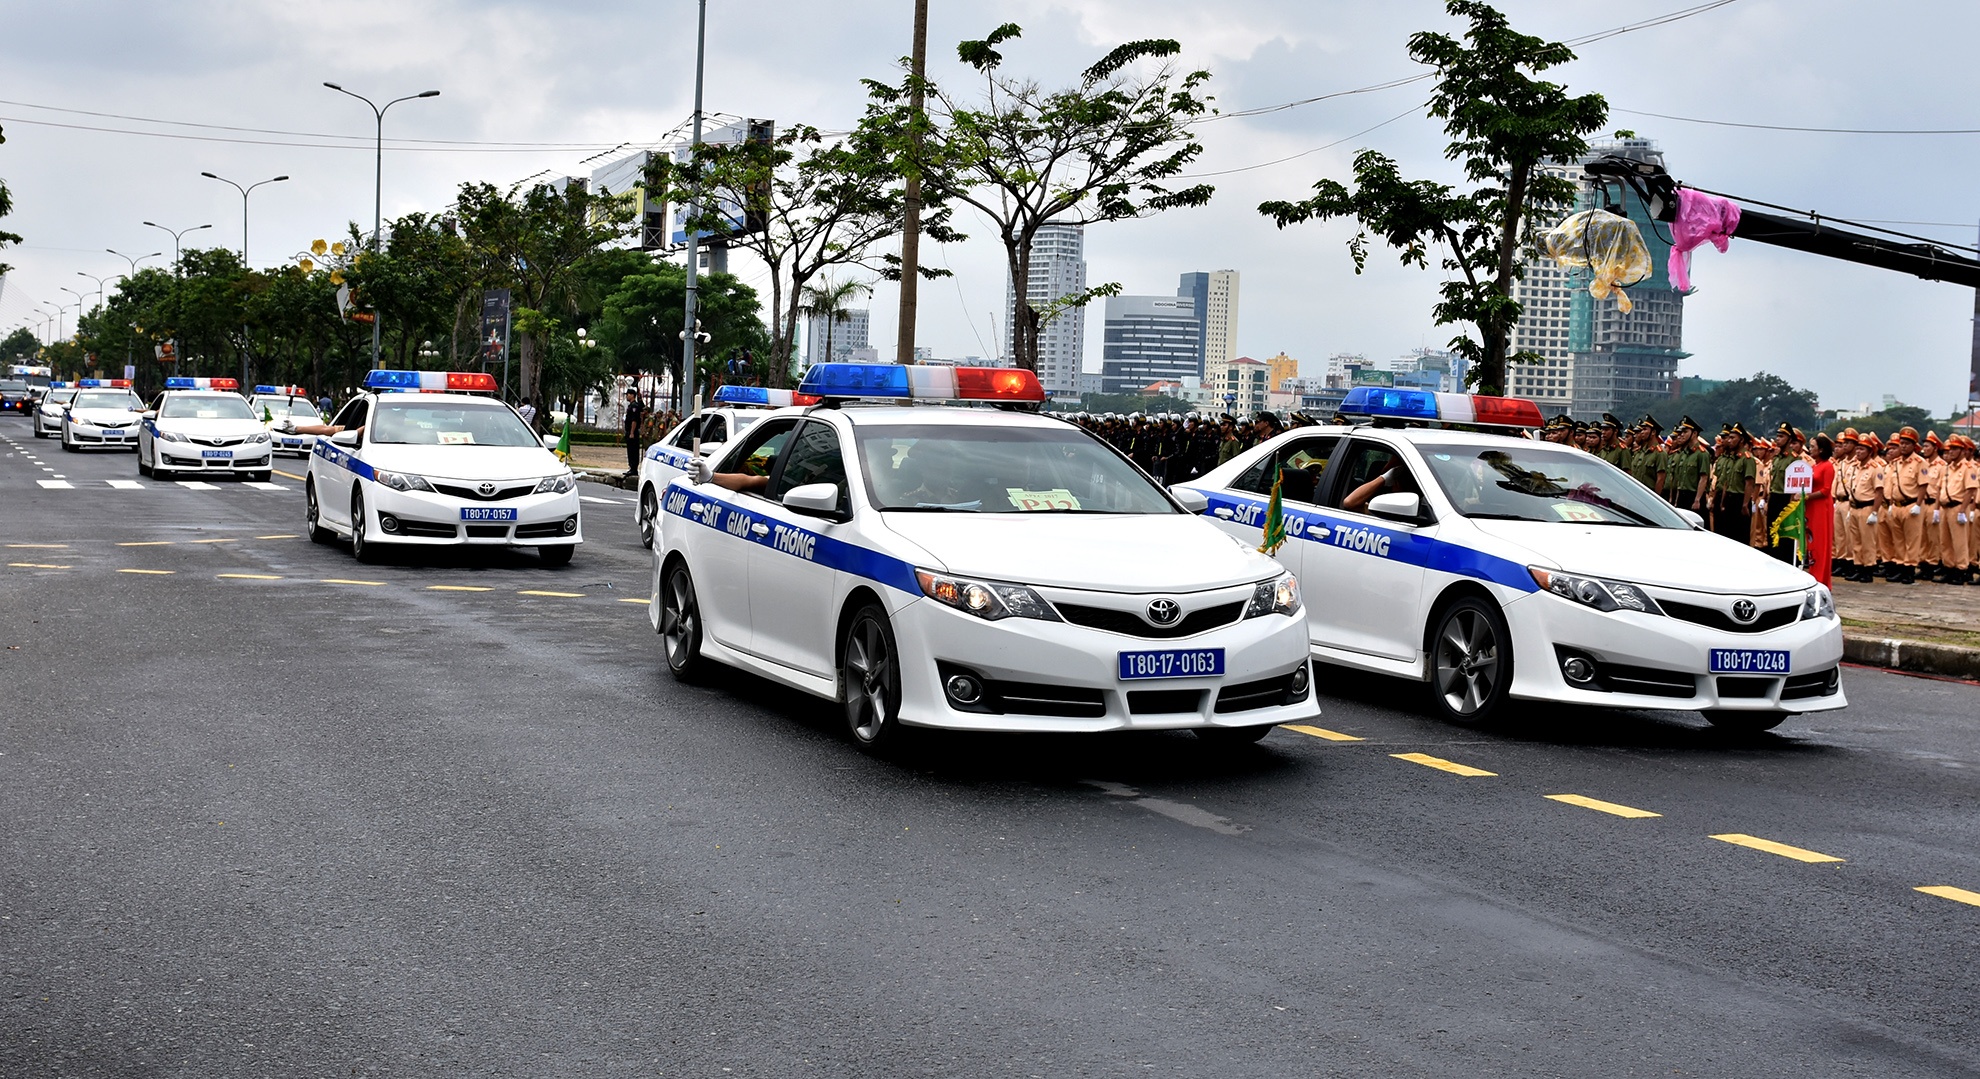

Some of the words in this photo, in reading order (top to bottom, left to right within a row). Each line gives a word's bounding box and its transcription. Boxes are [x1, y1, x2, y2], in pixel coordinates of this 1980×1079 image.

[464, 508, 512, 519] T80-17-0157
[666, 488, 688, 514] CẢNH
[702, 501, 722, 527] SÁT
[727, 512, 751, 537] GIAO
[774, 525, 816, 560] THÔNG
[1233, 502, 1262, 525] SÁT
[1334, 525, 1391, 557] THÔNG
[1127, 652, 1215, 675] T80-17-0163
[1716, 651, 1785, 670] T80-17-0248
